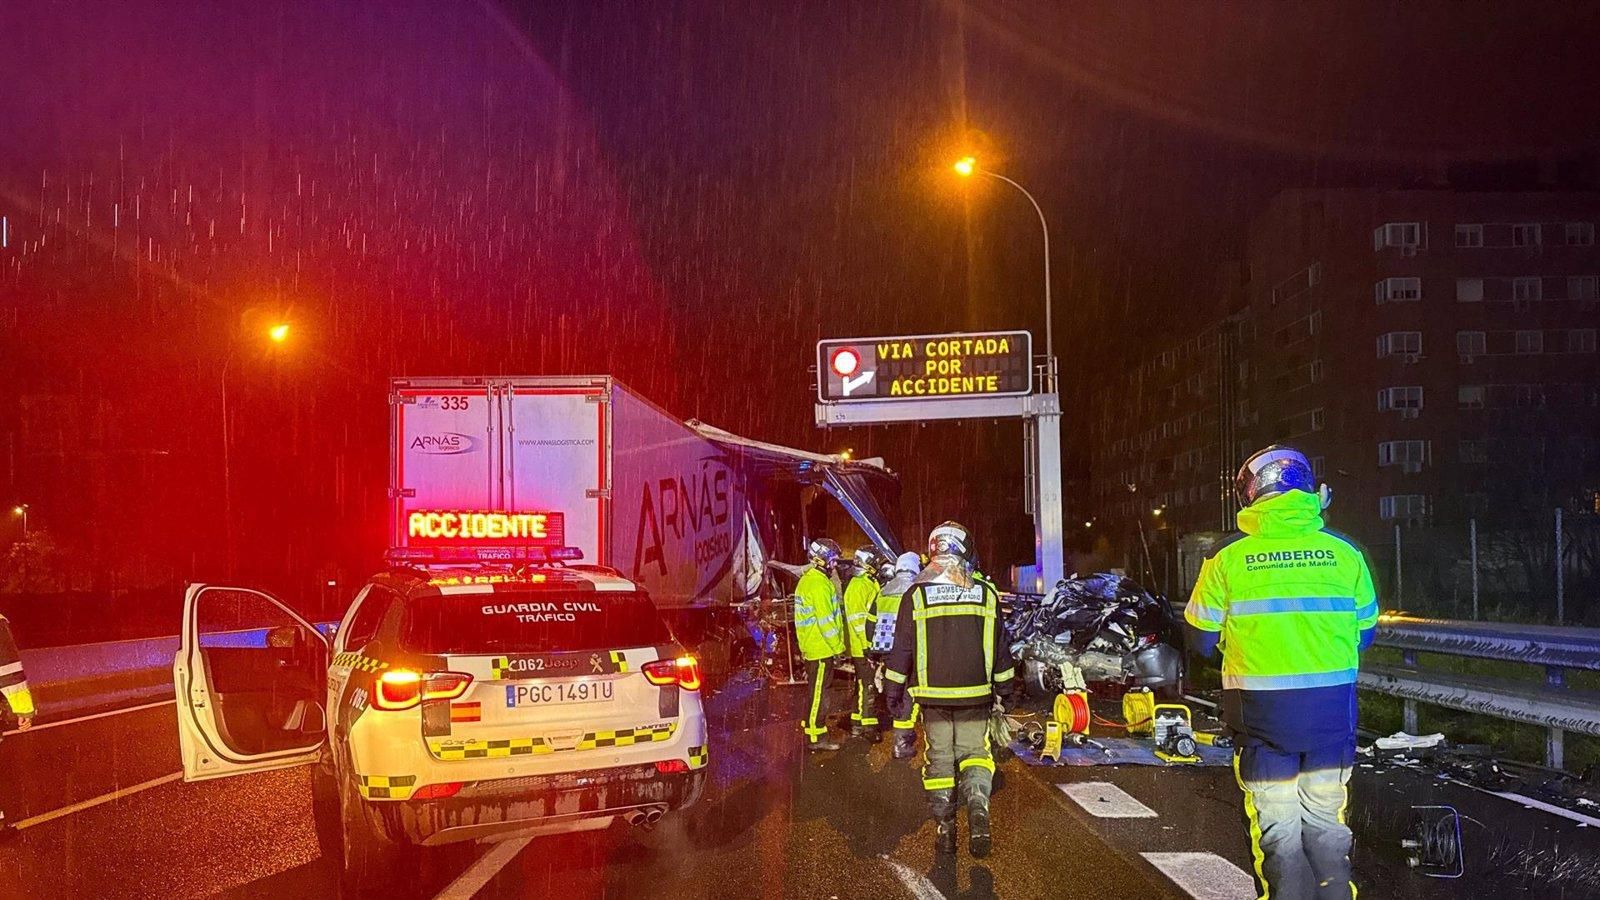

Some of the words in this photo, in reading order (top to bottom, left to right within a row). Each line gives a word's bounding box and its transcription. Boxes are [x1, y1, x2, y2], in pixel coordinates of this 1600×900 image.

[877, 342, 913, 360] VIA
[925, 338, 1010, 357] CORTADA
[925, 359, 962, 376] POR
[890, 375, 998, 395] ACCIDENTE
[441, 396, 469, 410] 335
[409, 512, 548, 538] ACCIDENTE
[1245, 549, 1335, 565] BOMBEROS
[1246, 562, 1294, 572] Comunidad
[482, 602, 558, 615] GUARDIA
[563, 602, 601, 612] CIVIL
[516, 612, 576, 623] TRÁFICO
[508, 658, 544, 672] C062
[544, 658, 578, 670] Jeep
[518, 685, 552, 704] PGC
